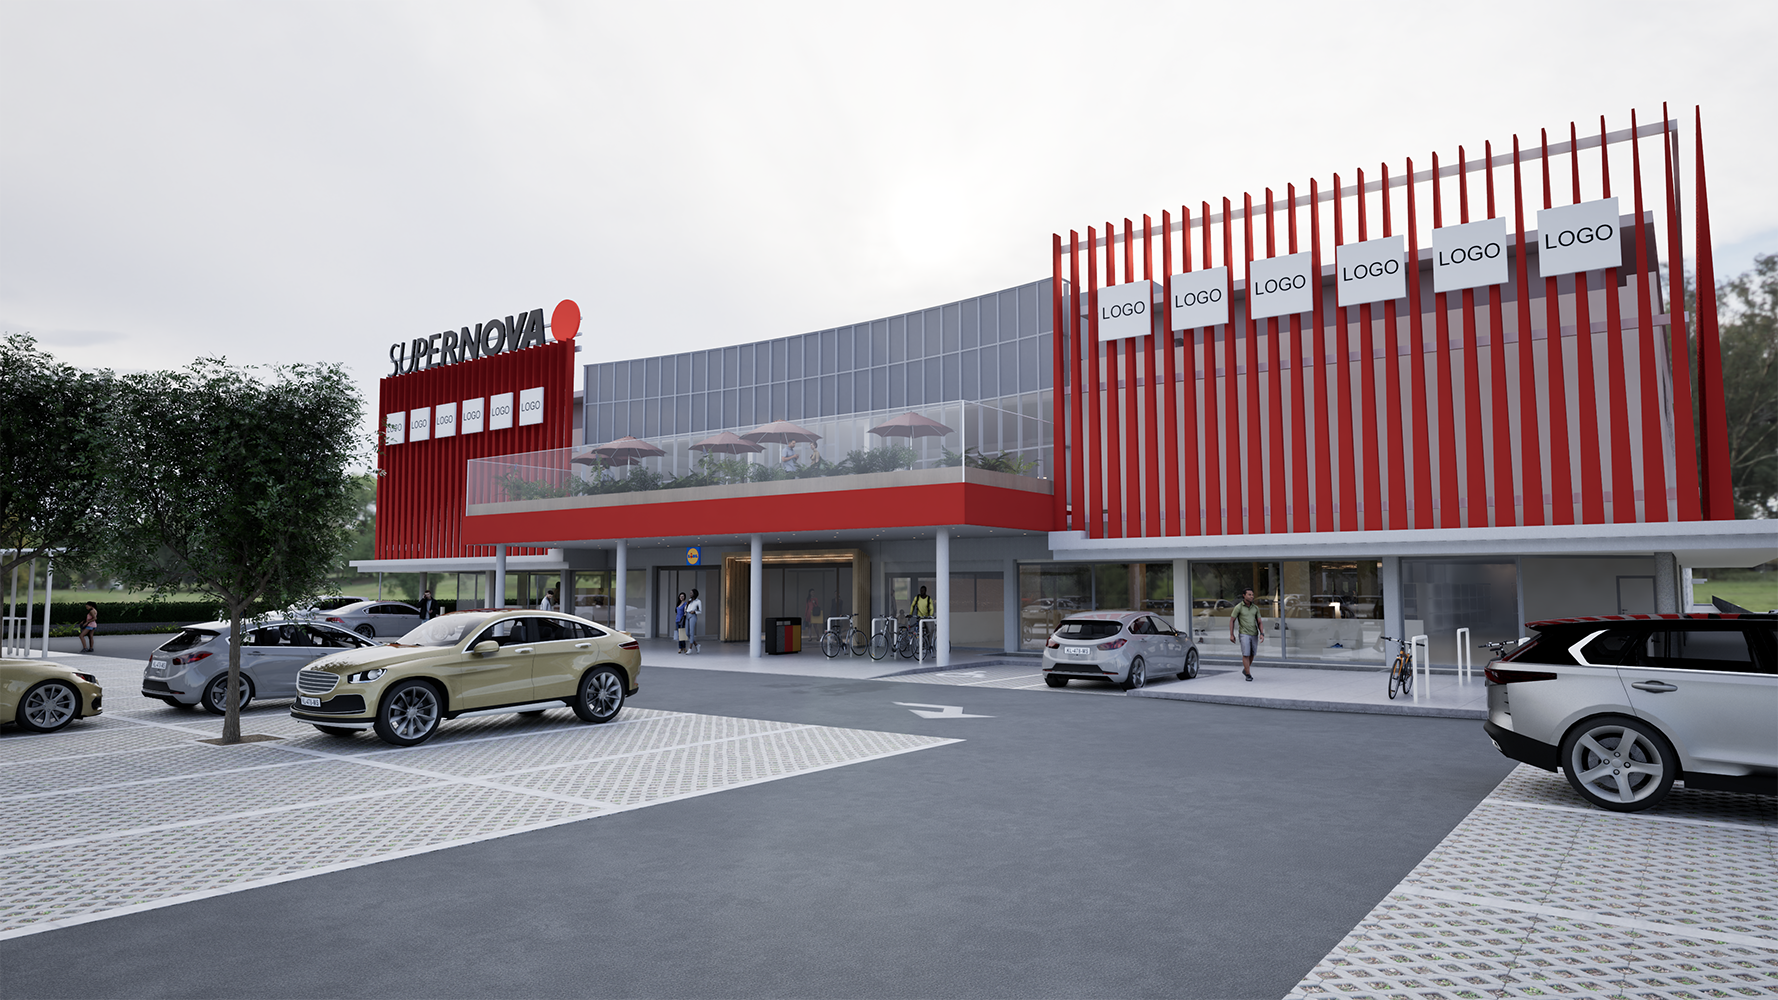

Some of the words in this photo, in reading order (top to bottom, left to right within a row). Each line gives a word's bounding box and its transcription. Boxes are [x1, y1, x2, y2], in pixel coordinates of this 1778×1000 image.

[1545, 223, 1613, 249] LOGO
[1439, 242, 1501, 267] LOGO
[1343, 258, 1400, 282] LOGO
[1254, 274, 1307, 296] LOGO
[1174, 288, 1222, 309] LOGO
[1102, 300, 1146, 320] LOGO
[387, 308, 546, 378] SUPERNOVA
[463, 410, 481, 421] LOGO
[491, 405, 511, 417] LOGO
[521, 400, 541, 412] LOGO
[411, 419, 428, 429] LOGO
[436, 414, 454, 426] LOGO
